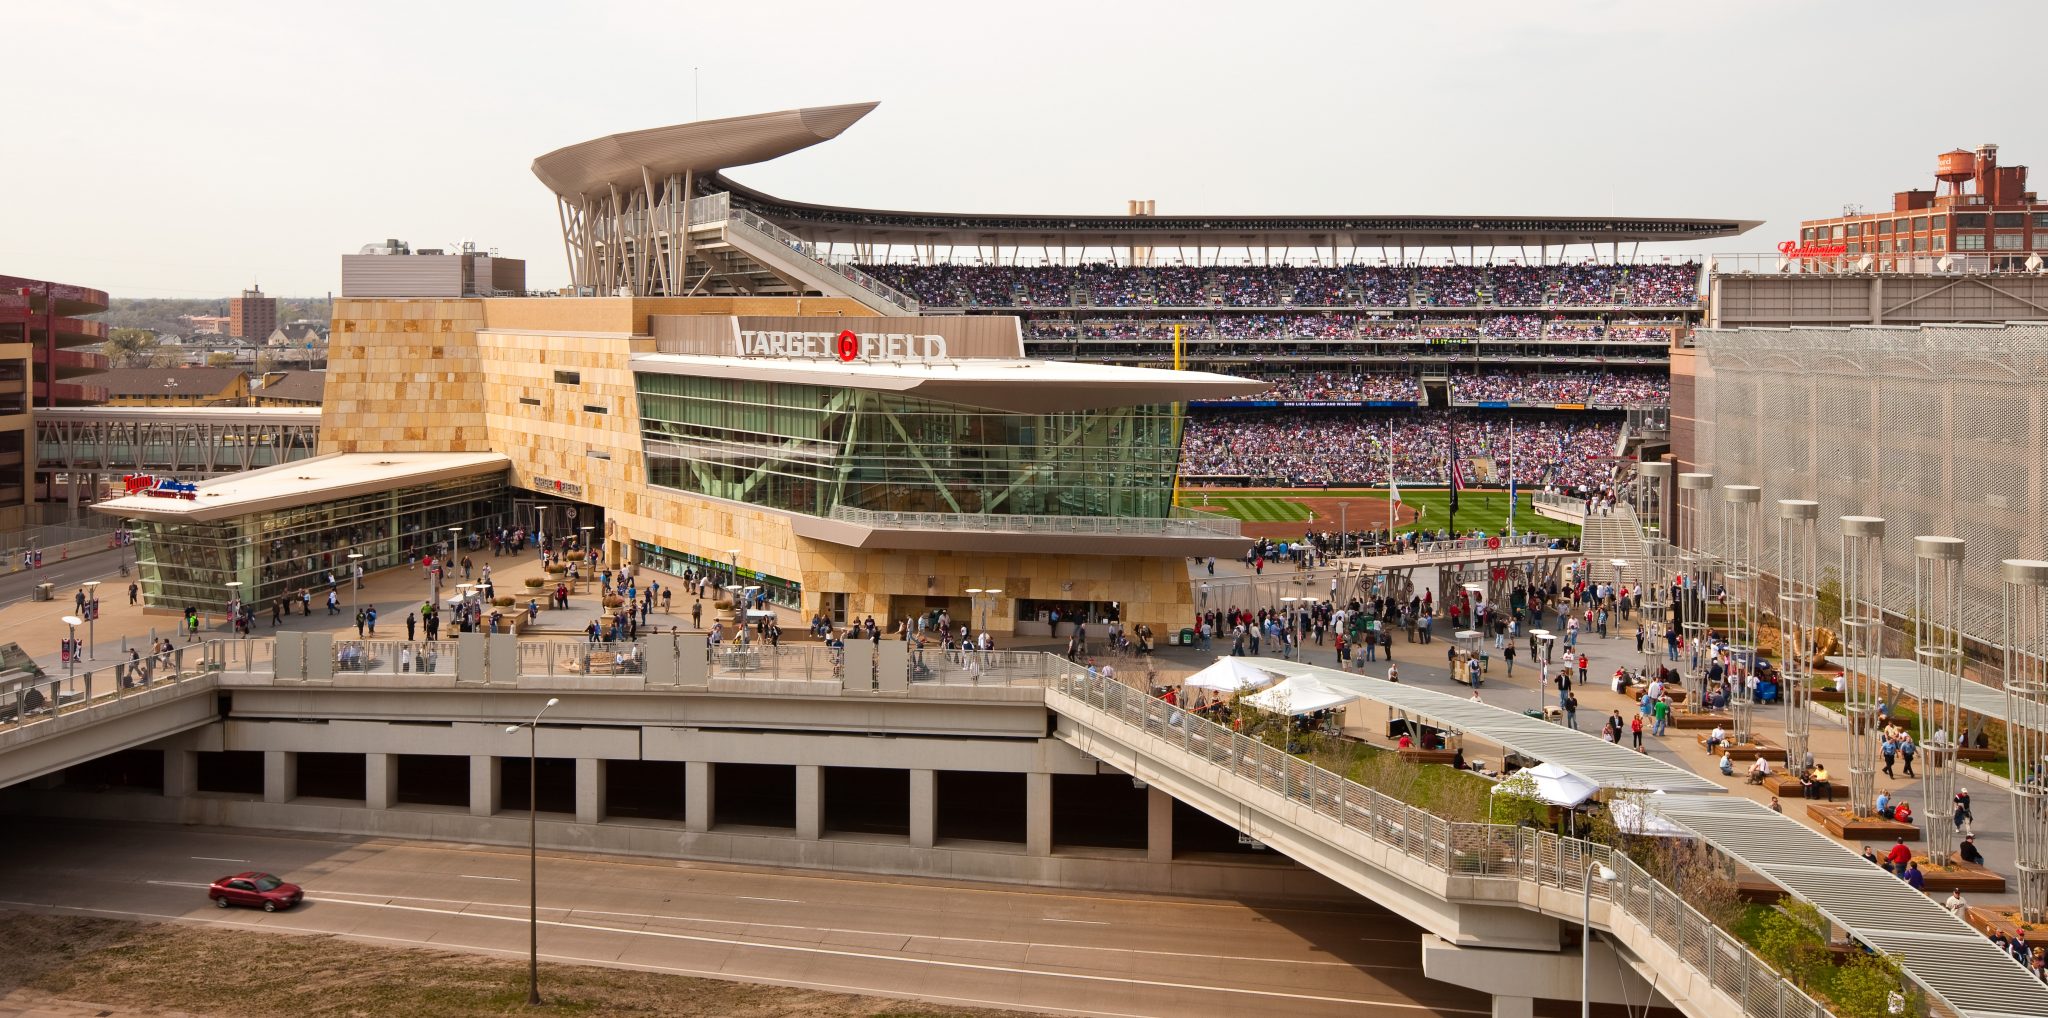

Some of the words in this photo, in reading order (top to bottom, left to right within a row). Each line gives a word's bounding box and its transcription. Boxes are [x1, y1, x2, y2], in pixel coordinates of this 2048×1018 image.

[741, 331, 836, 357] TARGET
[861, 333, 947, 362] FIELD
[1454, 570, 1488, 583] GATE
